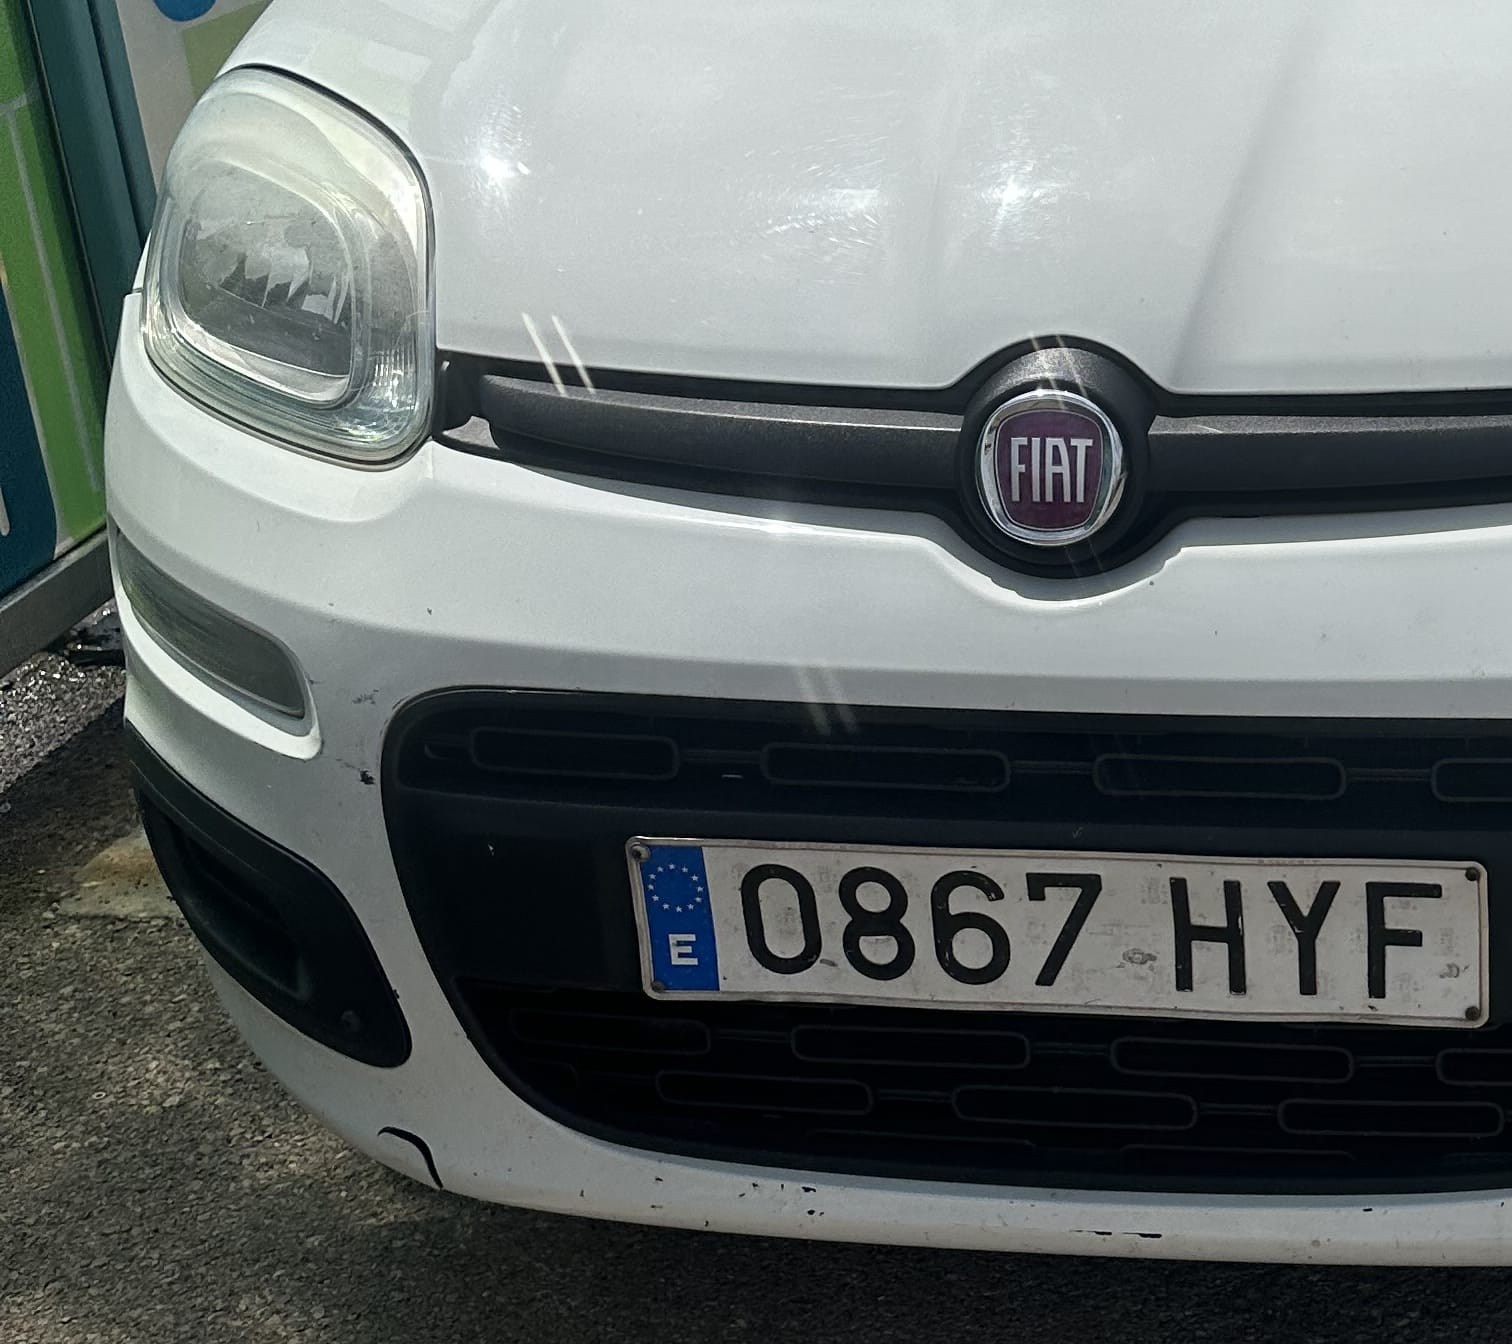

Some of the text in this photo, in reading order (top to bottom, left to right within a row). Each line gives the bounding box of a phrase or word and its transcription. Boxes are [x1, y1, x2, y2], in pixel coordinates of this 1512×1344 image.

[1010, 436, 1093, 503] FIAT
[668, 862, 1443, 1000] E 0867 HYF
